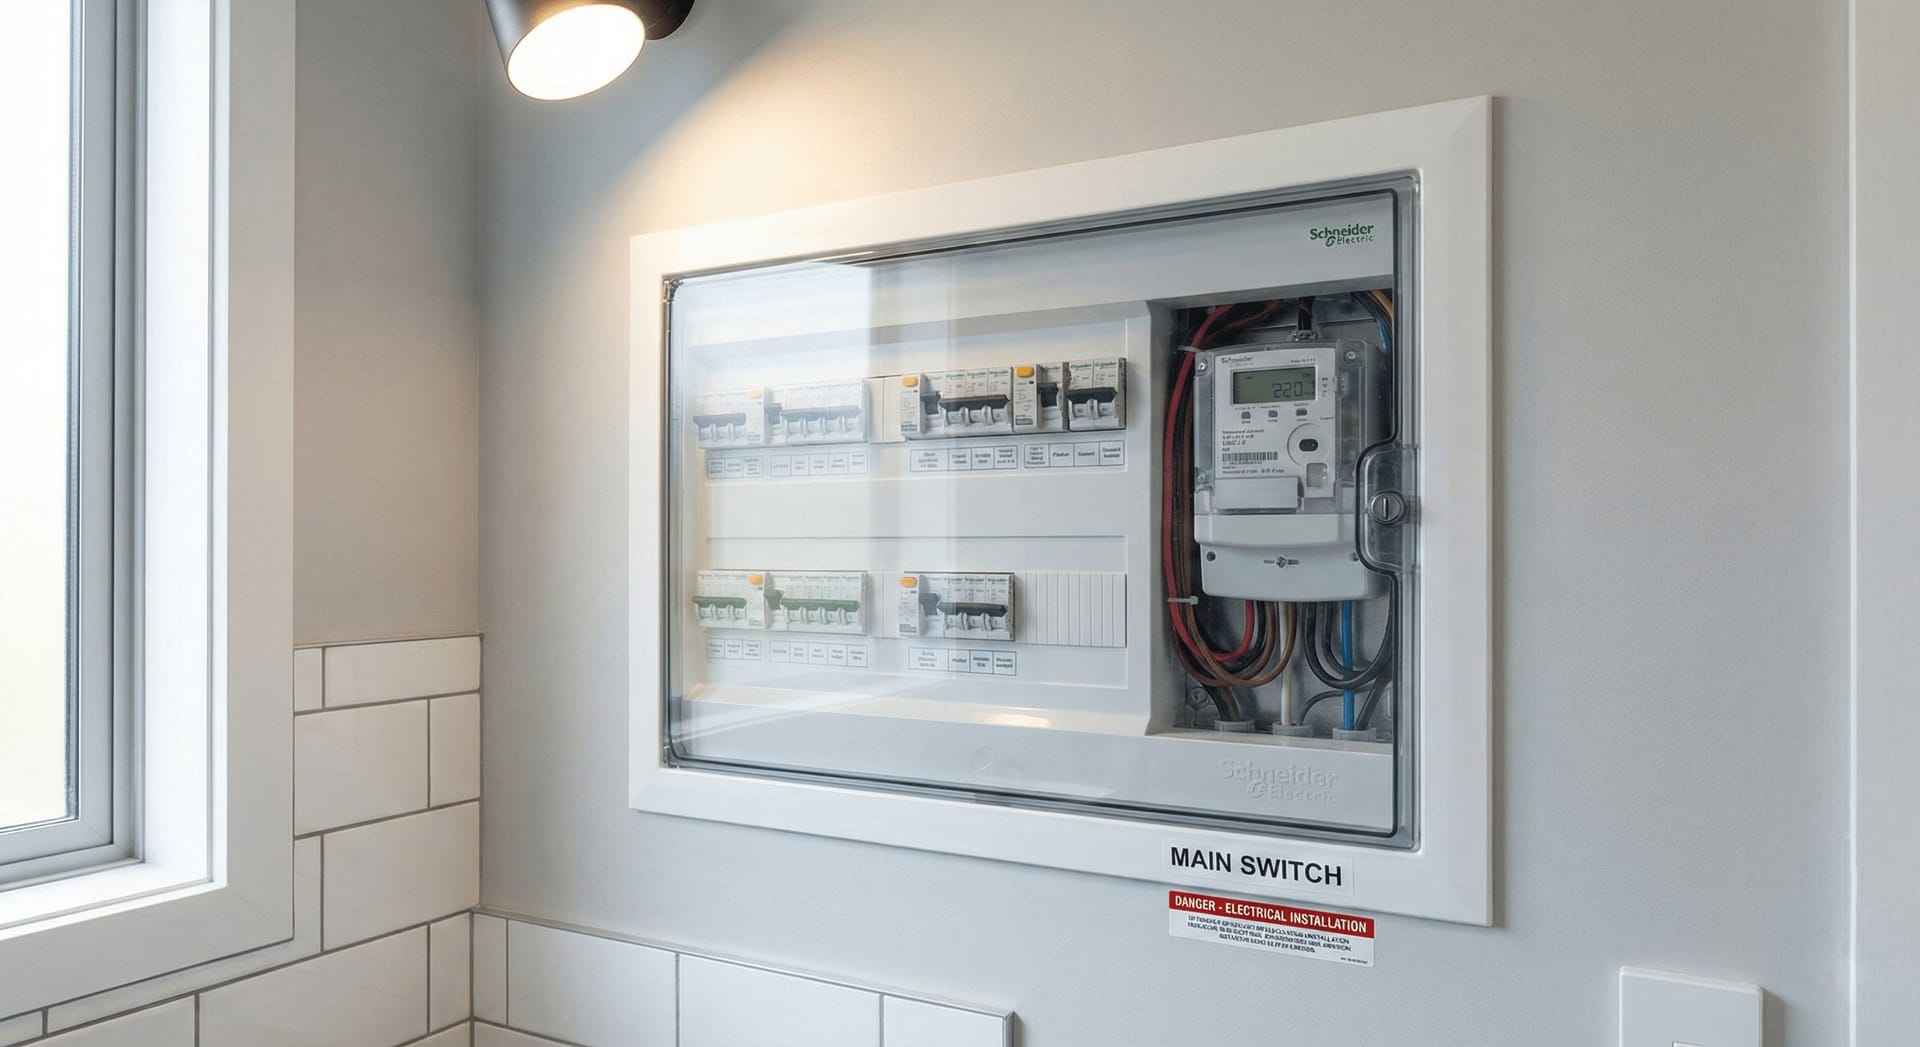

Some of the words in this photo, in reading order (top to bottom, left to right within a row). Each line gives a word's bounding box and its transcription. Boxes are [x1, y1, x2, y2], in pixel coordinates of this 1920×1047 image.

[1309, 223, 1375, 240] Schneider
[1336, 235, 1375, 245] Electric
[1220, 759, 1338, 787] Schneider
[1171, 846, 1232, 873] MAIN
[1240, 855, 1342, 886] SWITCH
[1175, 895, 1216, 911] DANGER
[1225, 902, 1287, 922] ELECTRICAL
[1290, 914, 1367, 933] INSTALLATION
